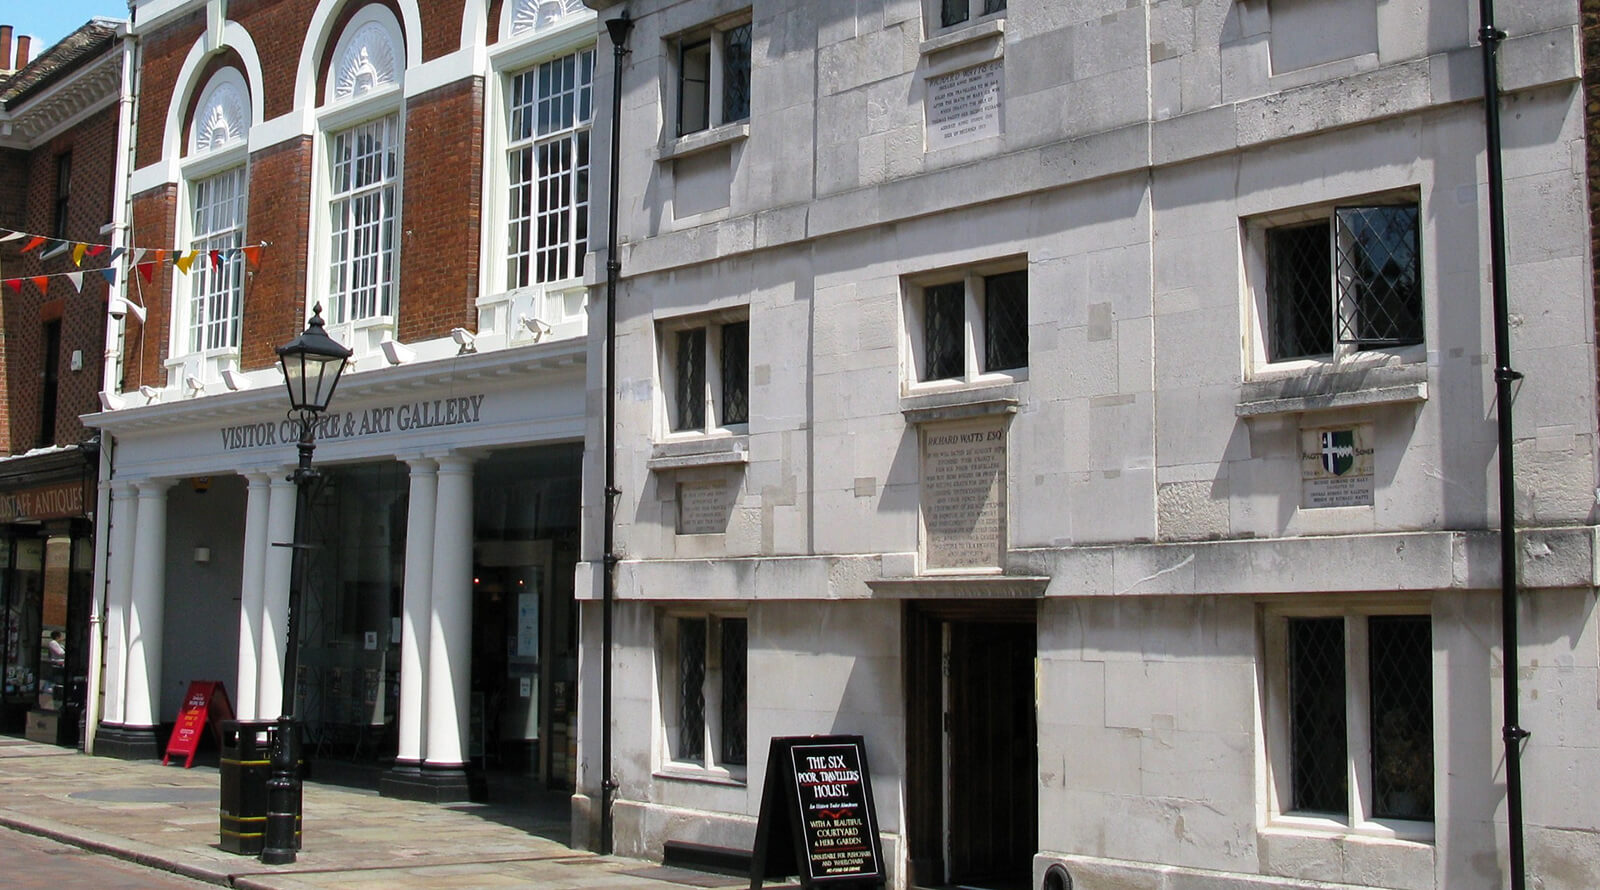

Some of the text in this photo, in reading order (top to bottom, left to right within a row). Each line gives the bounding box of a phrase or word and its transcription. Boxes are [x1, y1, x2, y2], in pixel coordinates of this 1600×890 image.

[221, 394, 485, 450] VISITOR CETRE & ART GALLERY
[928, 435, 959, 446] RICHARD
[960, 432, 984, 443] WATTS
[35, 488, 83, 515] ANTIQUES
[806, 755, 846, 769] THE SIX
[798, 770, 859, 783] POOR TRAVELLERS
[813, 784, 849, 798] HOUSE
[810, 820, 825, 828] WITH
[834, 818, 863, 826] BEAUTIFUL
[817, 827, 858, 837] COURTYARD
